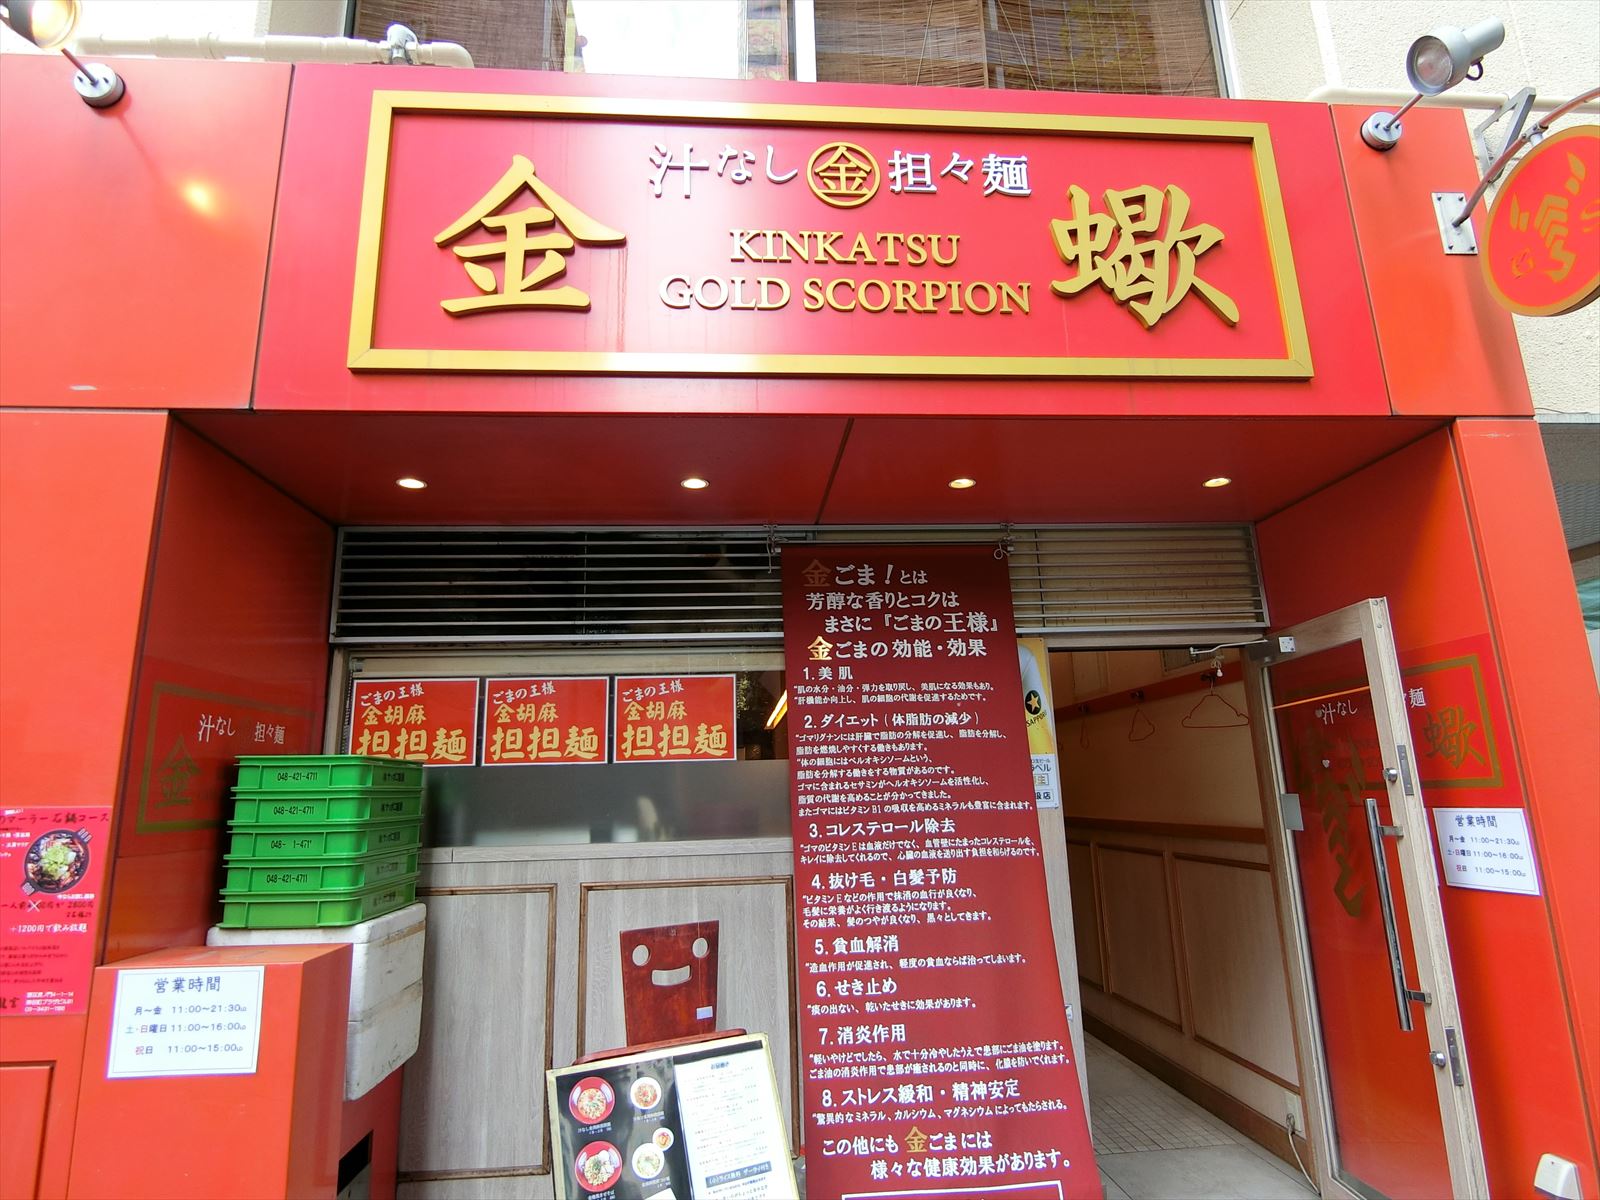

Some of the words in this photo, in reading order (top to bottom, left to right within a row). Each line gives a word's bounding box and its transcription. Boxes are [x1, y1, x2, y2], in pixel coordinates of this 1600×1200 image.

[649, 143, 798, 198] 汁なし
[811, 144, 875, 201] 金
[888, 151, 1032, 197] 担々麺
[434, 155, 627, 318] 金
[729, 228, 961, 266] KINKATSU
[1049, 184, 1240, 331] 蠍
[658, 274, 792, 311] GOLD
[802, 278, 1032, 315] SCORPION
[805, 591, 960, 610] 芳醇な香りとコクは
[807, 635, 988, 661] 金ごまの効能・効果
[361, 683, 425, 706] ごまの王様
[491, 680, 557, 705] ごまの王様
[621, 679, 685, 702] ごまの王様
[361, 704, 427, 725] 金胡麻
[493, 702, 559, 724] 金胡麻
[623, 700, 688, 722] 金胡麻
[1321, 700, 1358, 724] 汁なし
[198, 713, 236, 742] 汁なし
[254, 722, 286, 745] 担々麺
[621, 722, 728, 759] 担担麺
[356, 728, 467, 761] 担担麺
[490, 725, 599, 761] 担担麺
[155, 734, 201, 809] 金
[276, 771, 318, 782] 048-421-4711
[273, 805, 315, 815] 048-421-4711
[1455, 815, 1498, 828] 営業時間
[266, 873, 308, 884] 048-421-4711
[153, 976, 221, 994] 営業時間
[133, 1005, 162, 1016] 月～金
[125, 1024, 167, 1034] 土・日曜日
[135, 1045, 154, 1056] 祝日
